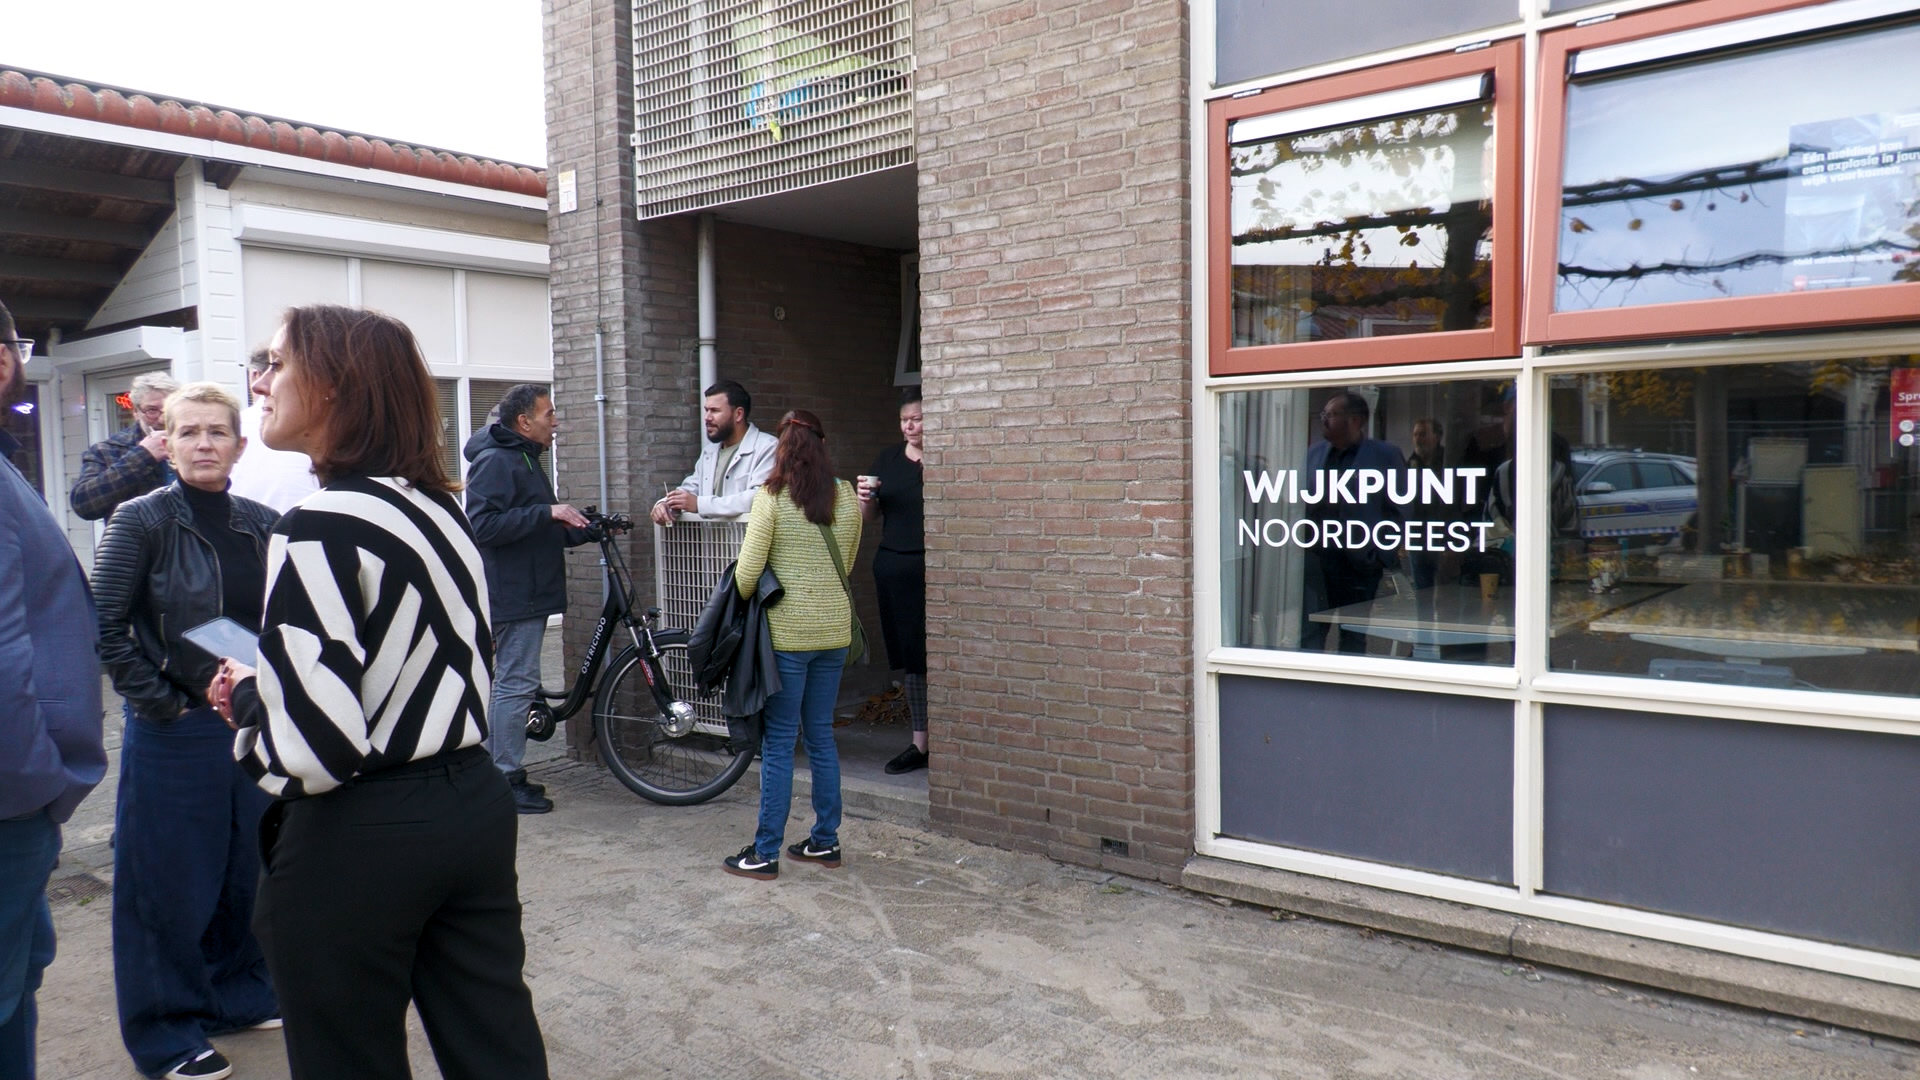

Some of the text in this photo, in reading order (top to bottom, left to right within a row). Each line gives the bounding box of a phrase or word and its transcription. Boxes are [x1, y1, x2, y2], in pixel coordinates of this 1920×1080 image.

[1802, 164, 1825, 175] een
[1827, 155, 1879, 171] explosie
[1882, 153, 1893, 164] in
[1827, 144, 1877, 160] melding
[1801, 173, 1827, 187] wijk
[1243, 467, 1486, 505] WIJKPUNT
[1238, 518, 1494, 553] NOORDGEEST
[581, 616, 606, 674] OSTRICHOO
